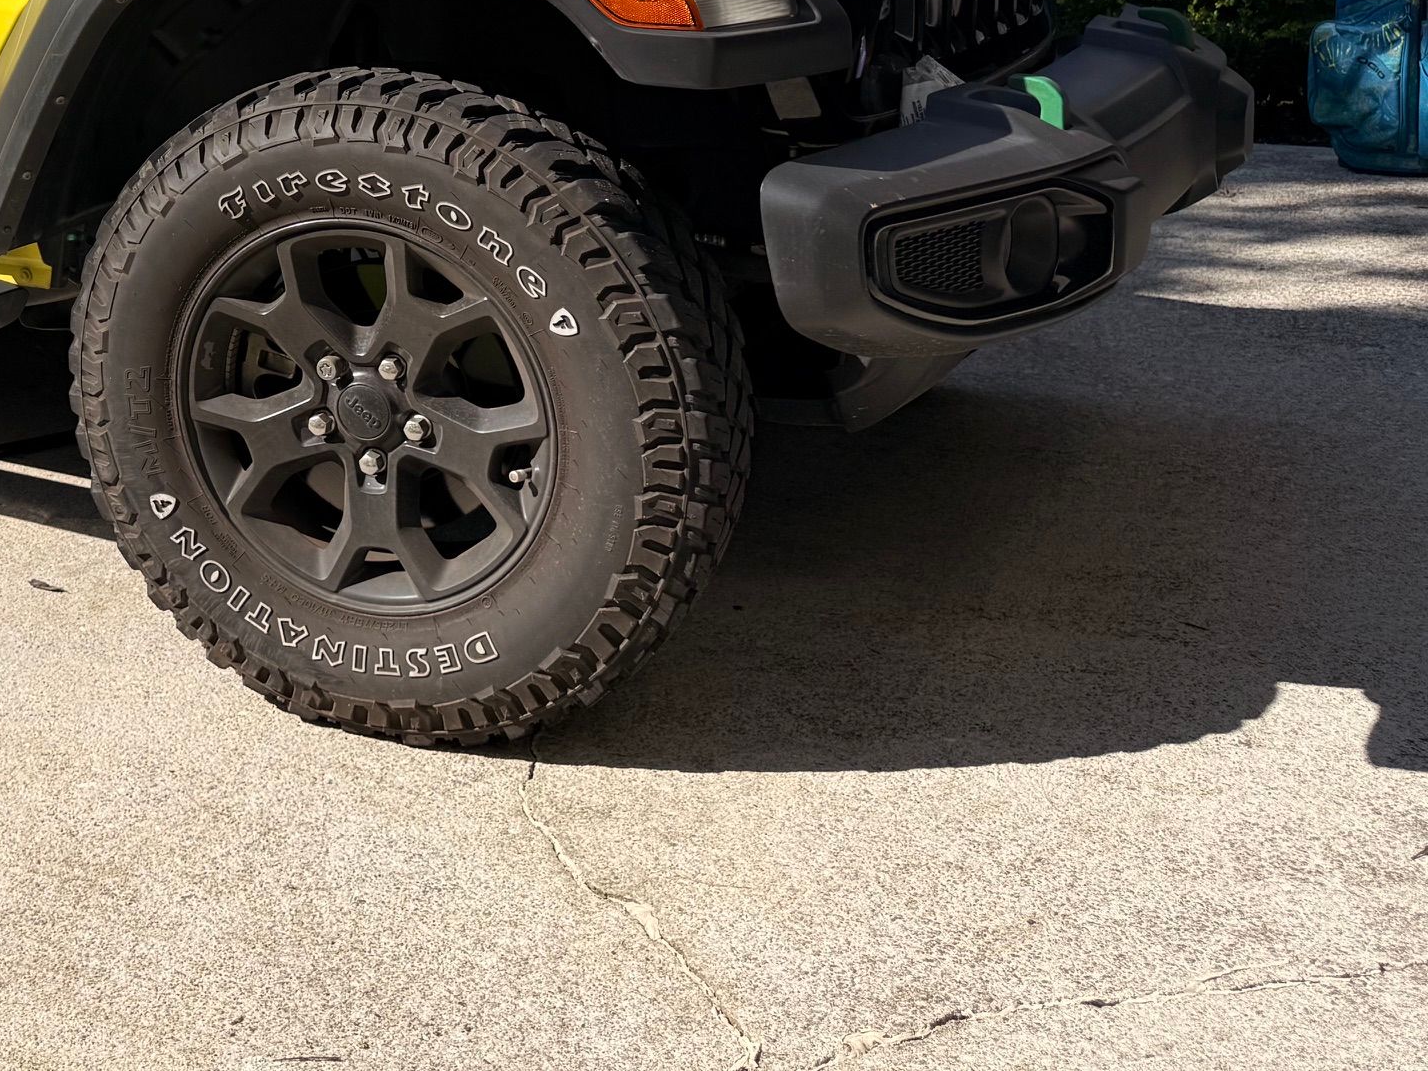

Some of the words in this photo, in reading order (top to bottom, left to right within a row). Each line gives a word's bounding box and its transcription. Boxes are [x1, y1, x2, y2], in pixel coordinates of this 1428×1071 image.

[1357, 56, 1386, 80] OGIO
[218, 167, 547, 299] Firestone
[345, 395, 383, 430] Jeep
[171, 525, 501, 678] DESTINATION
